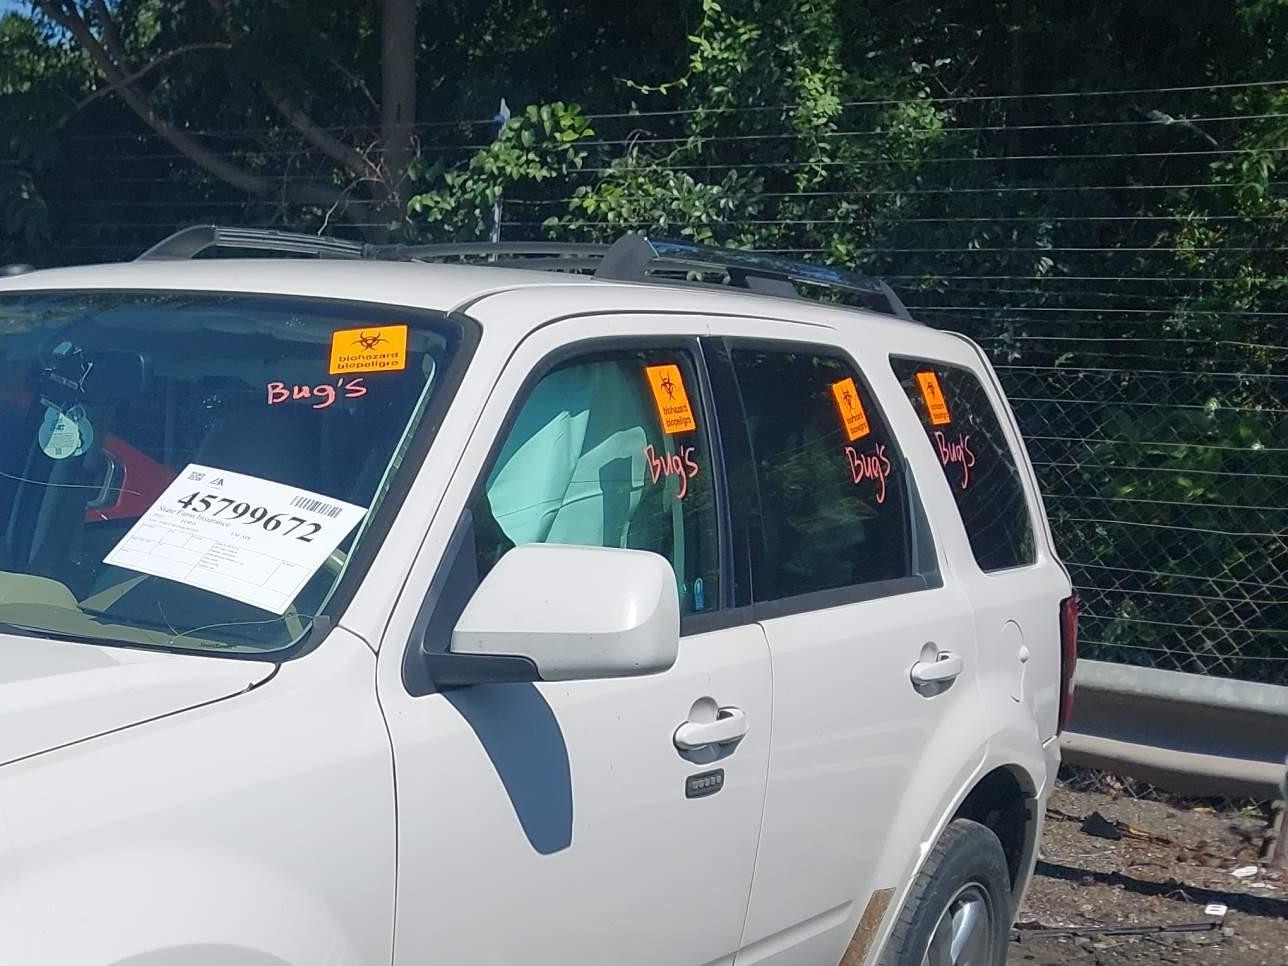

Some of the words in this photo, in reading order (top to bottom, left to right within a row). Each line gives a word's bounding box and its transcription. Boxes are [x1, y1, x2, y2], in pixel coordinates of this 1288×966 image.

[338, 351, 399, 363] biohazard
[337, 360, 400, 370] biopeligro
[177, 491, 323, 543] 45799672
